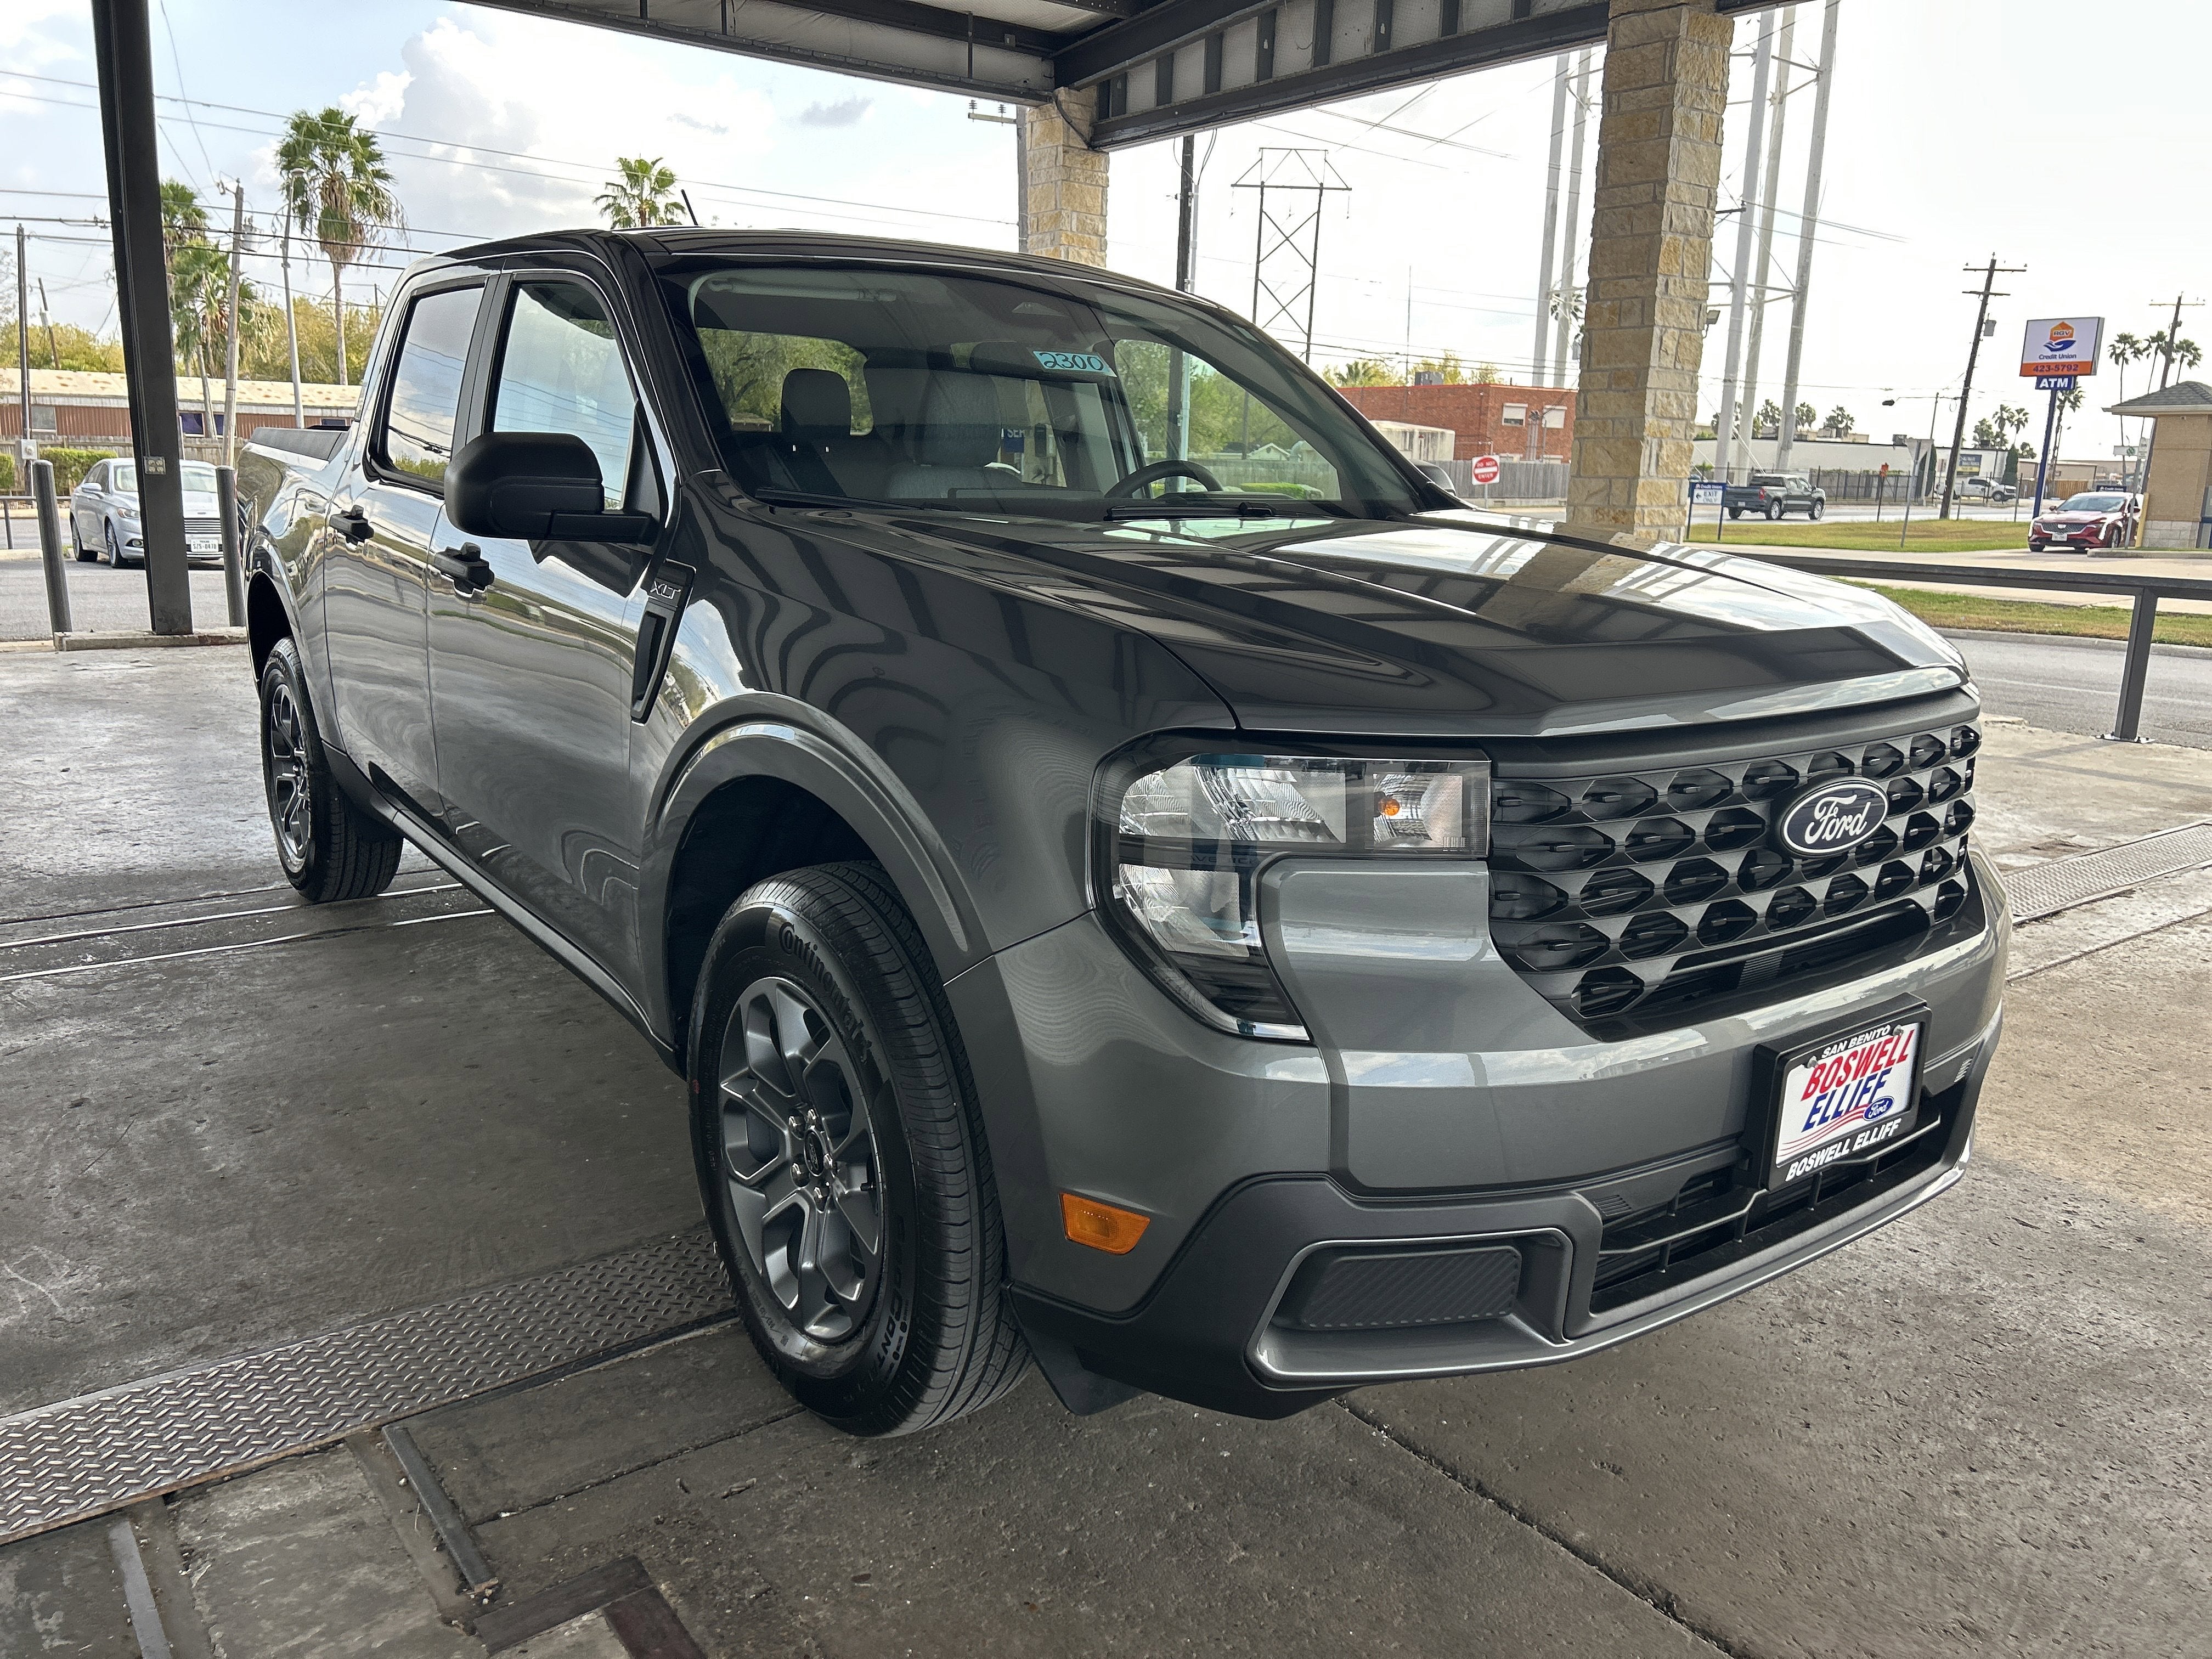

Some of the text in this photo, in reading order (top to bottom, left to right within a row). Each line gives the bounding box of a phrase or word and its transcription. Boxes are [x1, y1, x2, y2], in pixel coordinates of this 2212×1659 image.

[1039, 352, 1104, 371] 2300
[2033, 364, 2079, 372] 423-5792
[2039, 378, 2068, 388] ATM
[650, 580, 681, 599] XLT
[1805, 794, 1871, 844] Ford
[1821, 1025, 1891, 1059] SAN BENITO
[1801, 1029, 1915, 1102] BOSWELL
[1802, 1068, 1892, 1133] ELLIFF
[1869, 1099, 1889, 1119] Ford
[1785, 1119, 1902, 1182] BOSWELL ELLIFF
